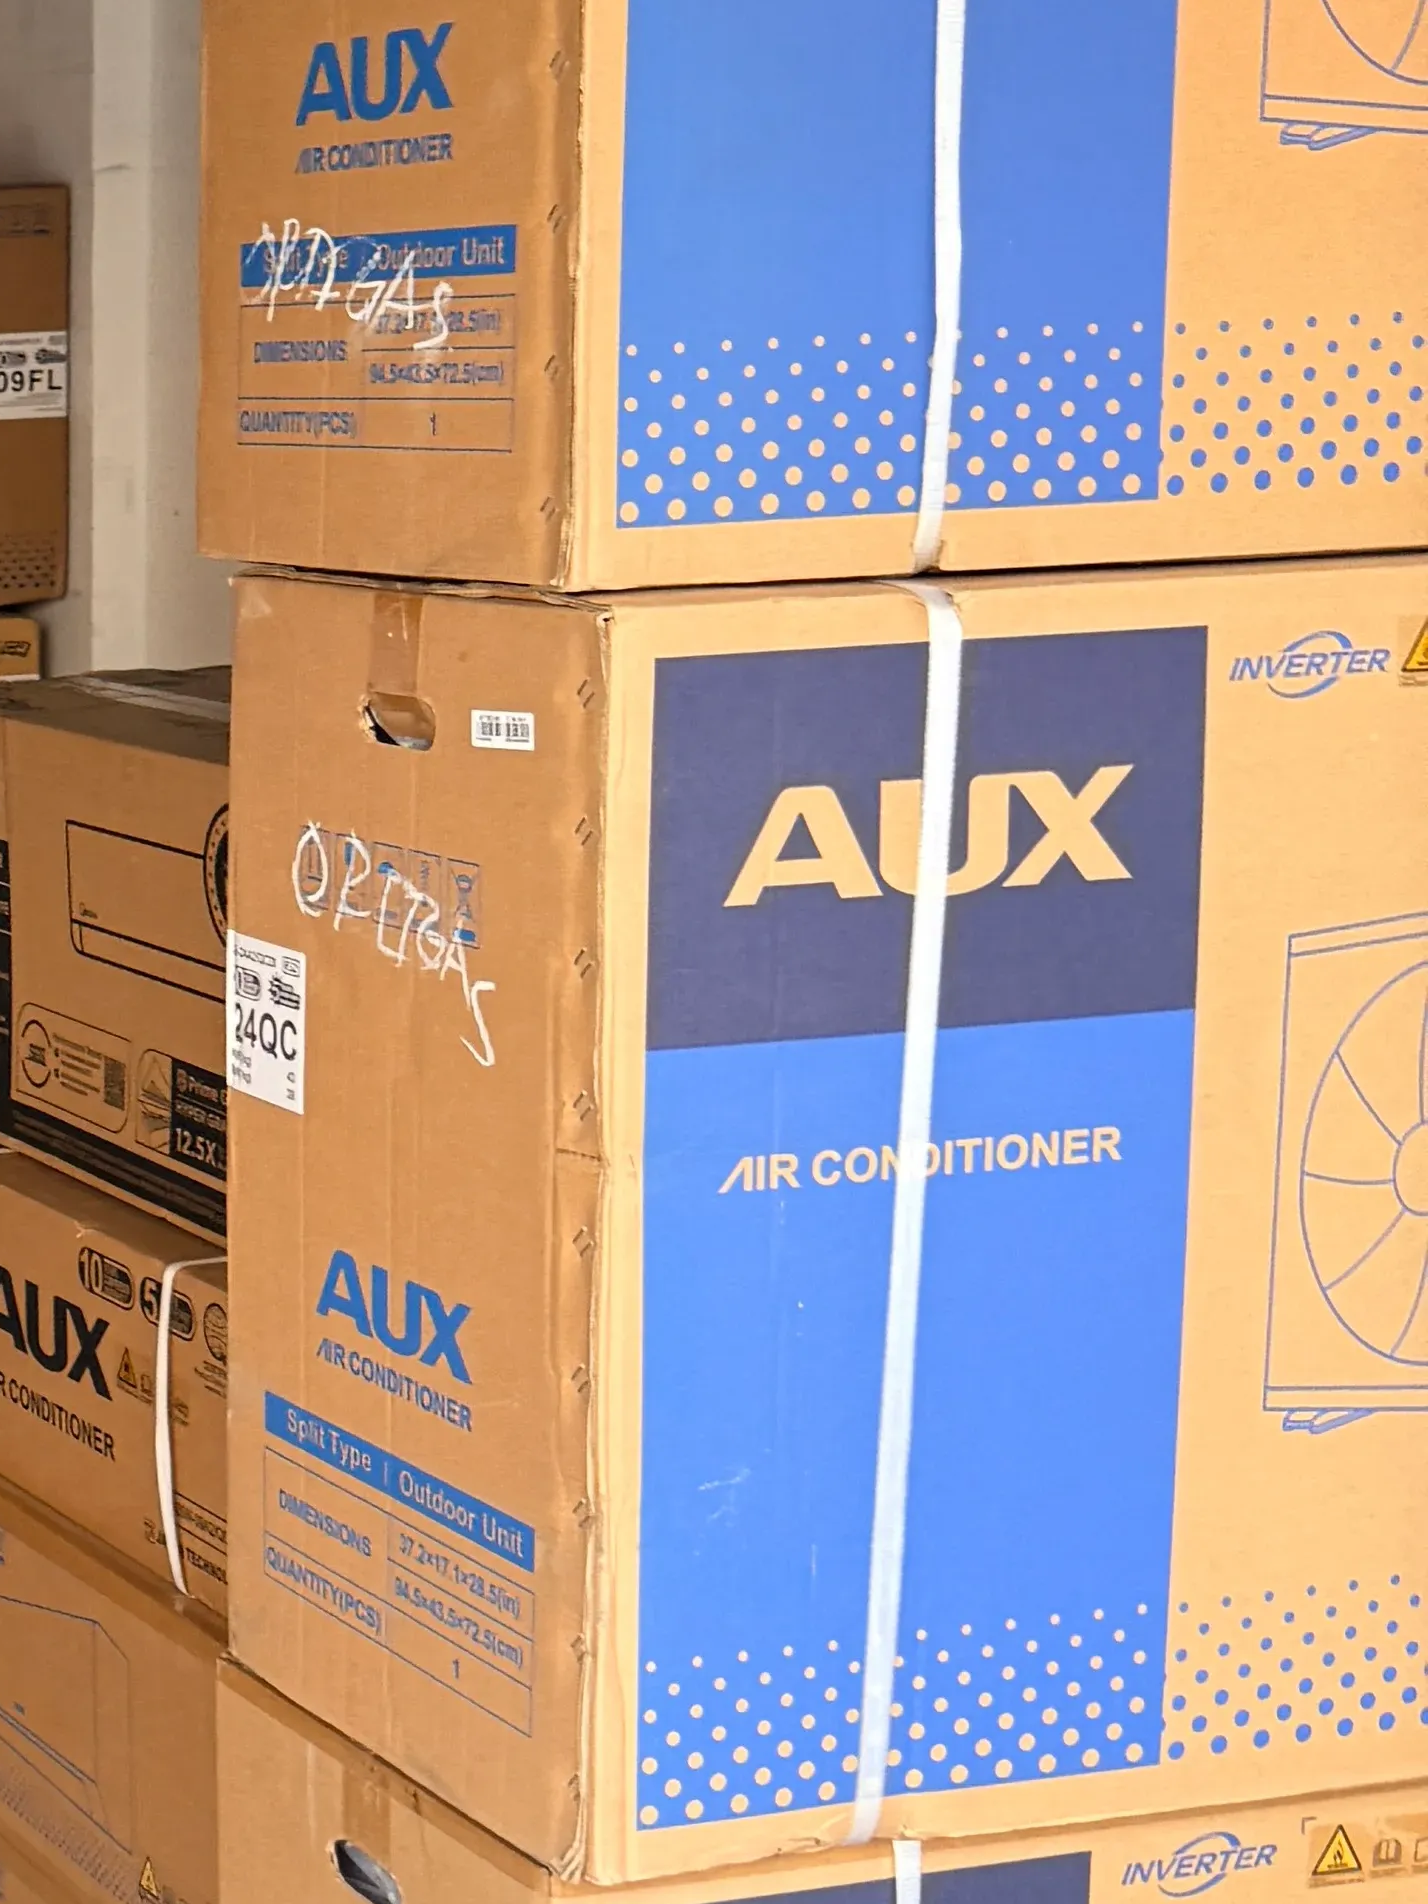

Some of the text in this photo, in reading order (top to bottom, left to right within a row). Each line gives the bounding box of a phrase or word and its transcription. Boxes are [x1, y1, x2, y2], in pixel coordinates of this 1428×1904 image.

[295, 21, 456, 127] AUX
[462, 237, 505, 266] Unit
[1229, 647, 1391, 682] INVERTER
[723, 763, 1134, 908] AUX
[235, 1002, 298, 1062] 24QC
[719, 1152, 800, 1195] AIR
[315, 1249, 473, 1386] AUX
[9, 1377, 117, 1462] CONDITIONER
[316, 1337, 473, 1433] AIR CONDITIONER
[278, 1487, 372, 1558] DIMENSIONS
[286, 1407, 524, 1559] Split Type Outdoor Unit
[264, 1546, 461, 1679] QUANTITY(PCS) 1
[1122, 1843, 1278, 1887] INVERTER
